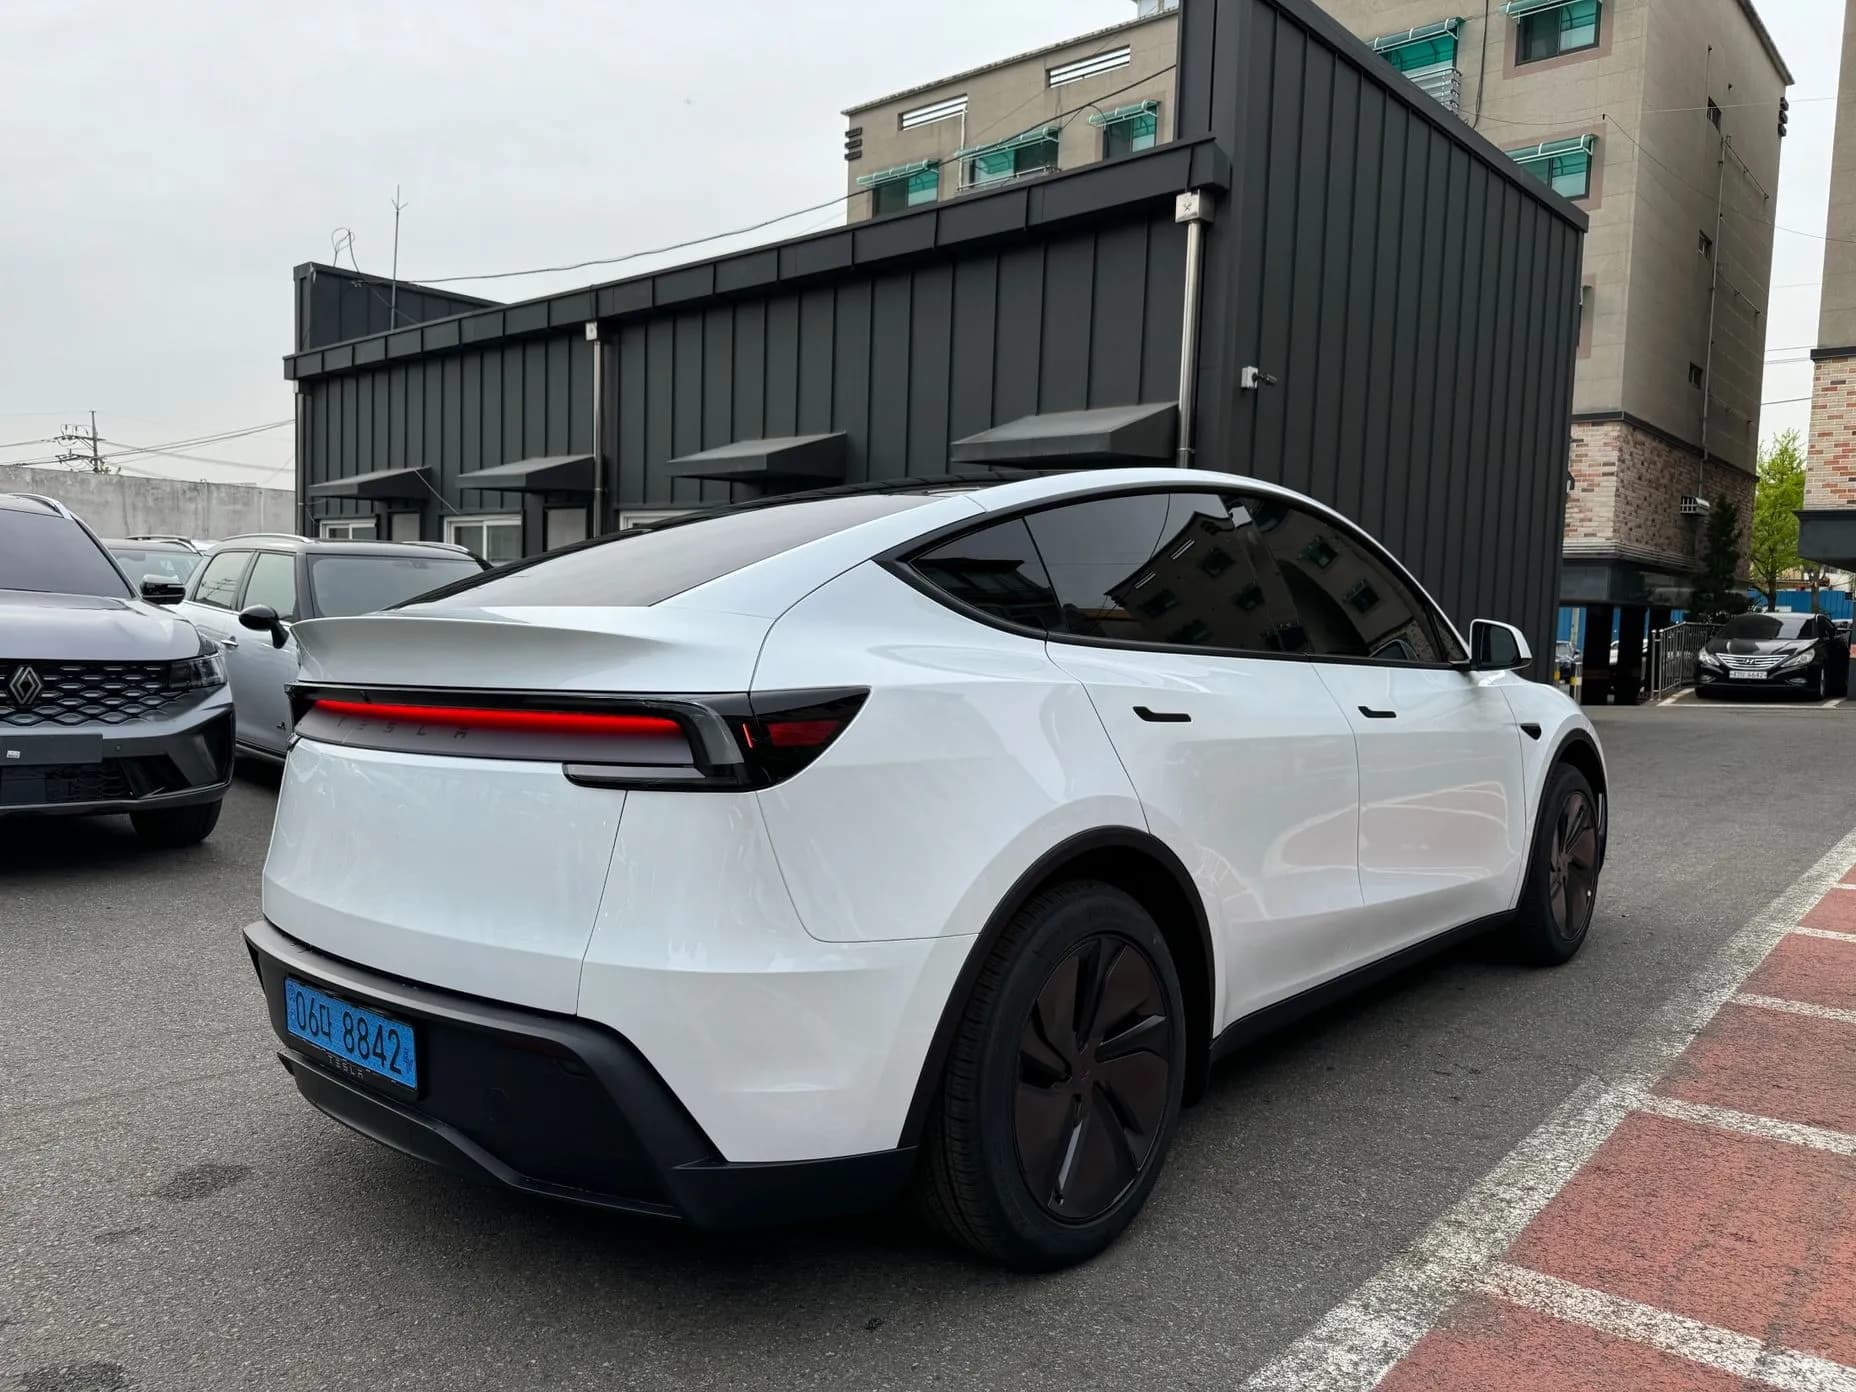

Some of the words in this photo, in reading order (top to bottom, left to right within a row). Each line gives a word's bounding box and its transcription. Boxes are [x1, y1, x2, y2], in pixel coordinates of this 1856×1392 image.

[336, 716, 468, 740] TESLA
[342, 1010, 402, 1075] 8842
[327, 1054, 364, 1079] TESLA
